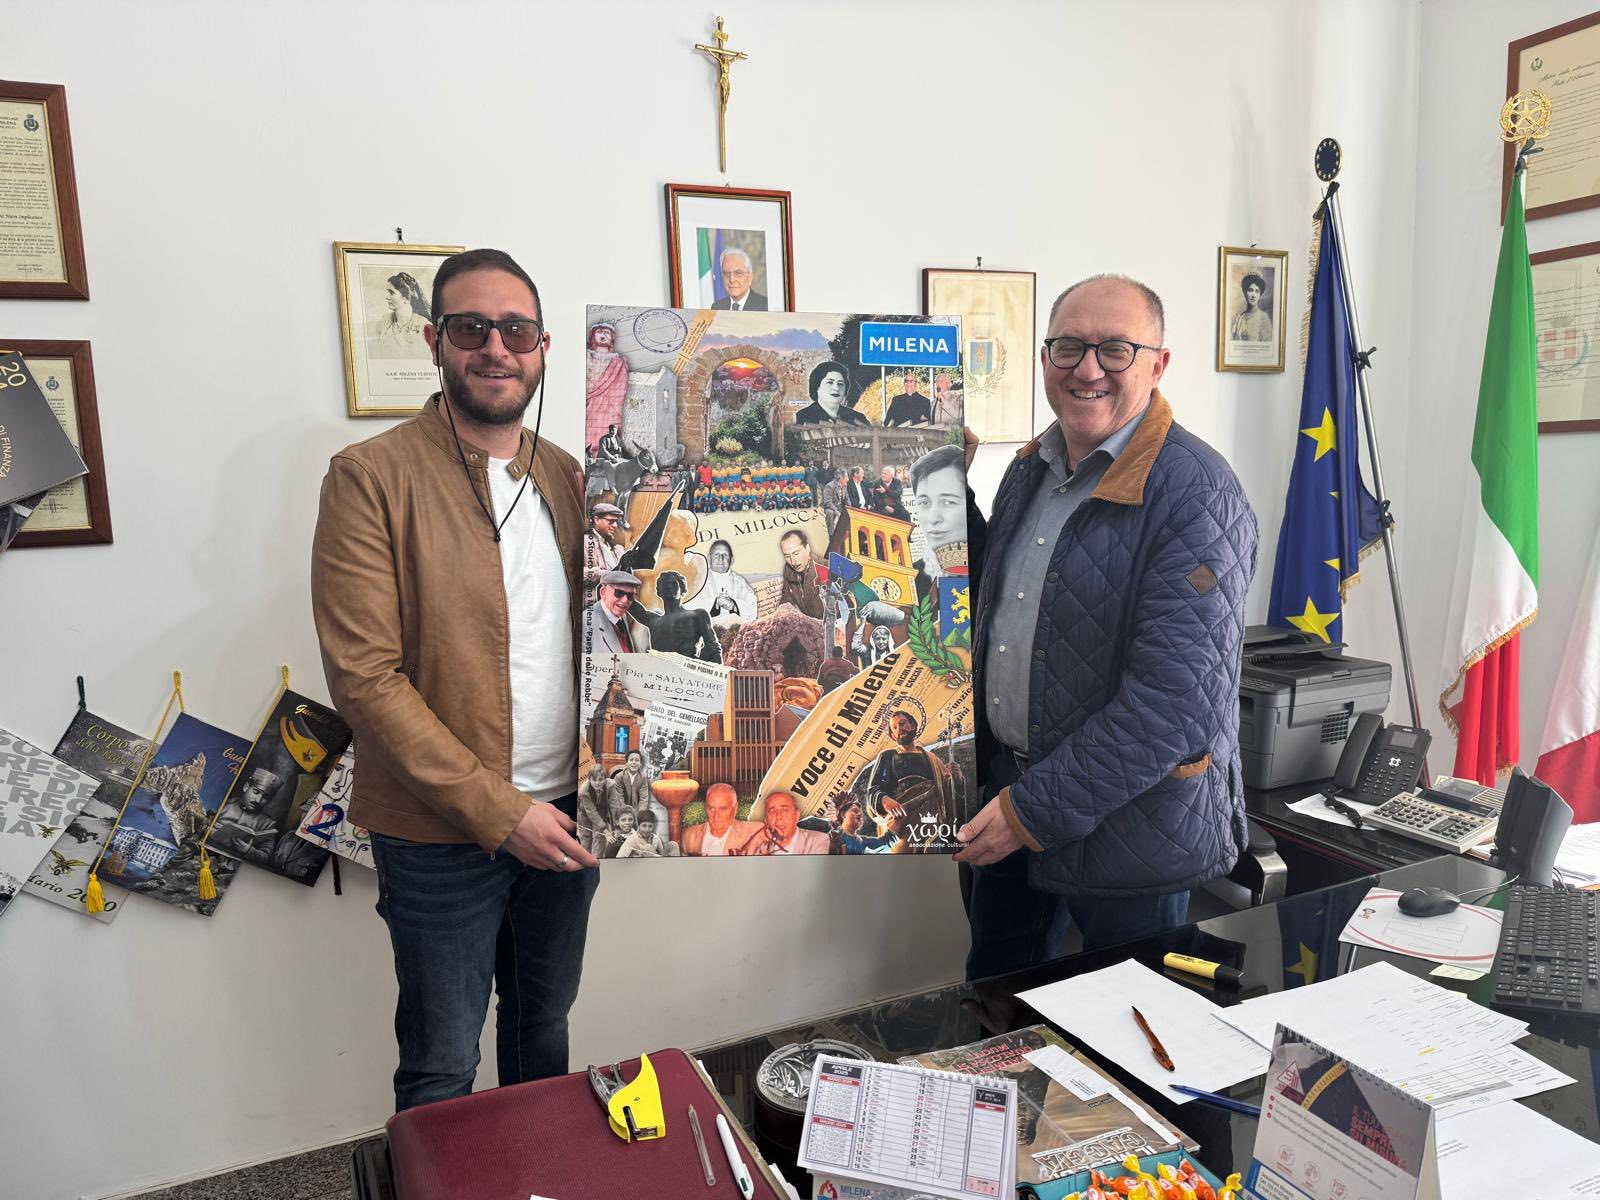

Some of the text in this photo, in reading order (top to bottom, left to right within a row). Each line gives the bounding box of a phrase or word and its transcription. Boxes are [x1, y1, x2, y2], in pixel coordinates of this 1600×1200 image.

[869, 337, 949, 354] MILENA
[698, 528, 720, 543] DI
[587, 541, 595, 570] Storico
[625, 668, 643, 679] Pia
[643, 682, 714, 699] MILOCCA
[837, 653, 901, 726] Milena
[87, 724, 129, 749] Corpo
[824, 722, 853, 750] di
[66, 887, 117, 912] 20
[831, 1064, 853, 1073] APRILE
[1034, 1131, 1147, 1172] CACCIA
[840, 1185, 871, 1197] MILENA
